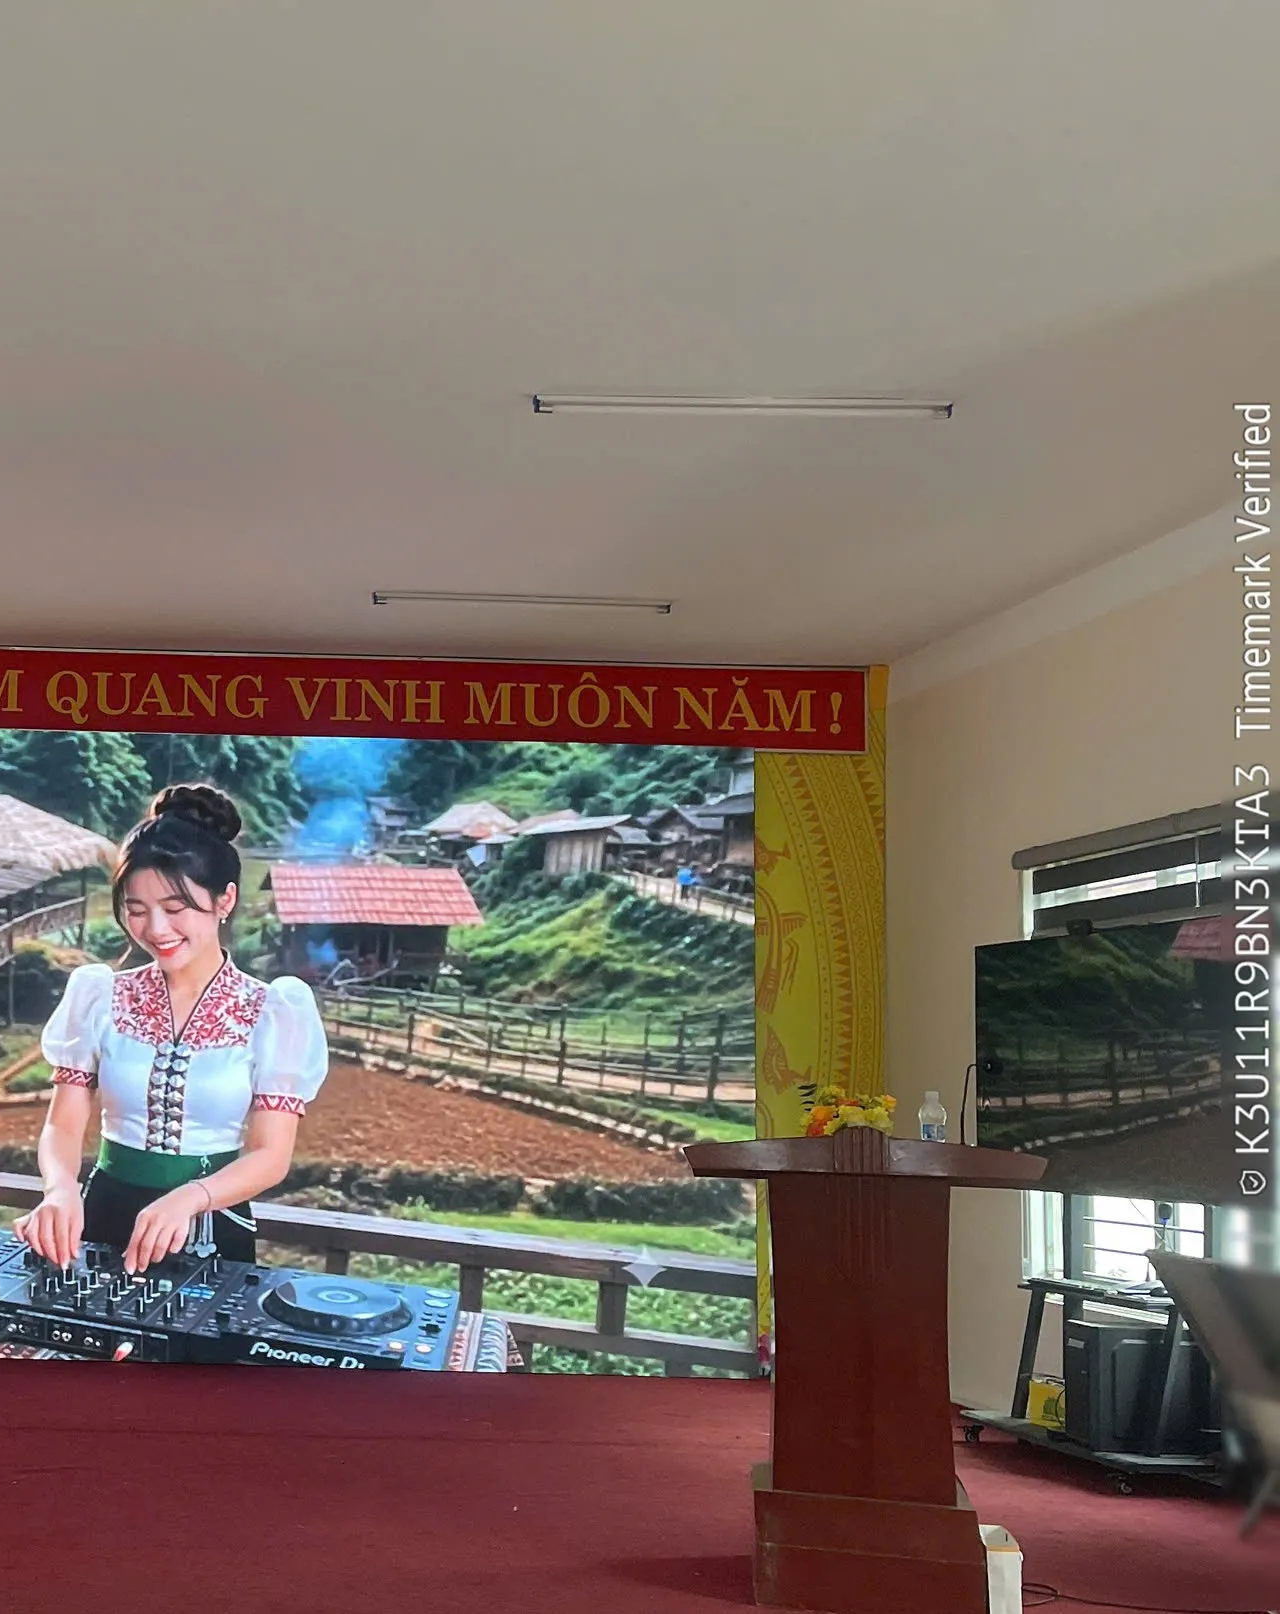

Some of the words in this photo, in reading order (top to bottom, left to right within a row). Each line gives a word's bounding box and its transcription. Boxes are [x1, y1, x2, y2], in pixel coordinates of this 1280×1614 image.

[45, 669, 269, 724] QUANG
[284, 676, 445, 724] VINH
[463, 671, 659, 729] MUÔN
[249, 1341, 336, 1367] Pioneer
